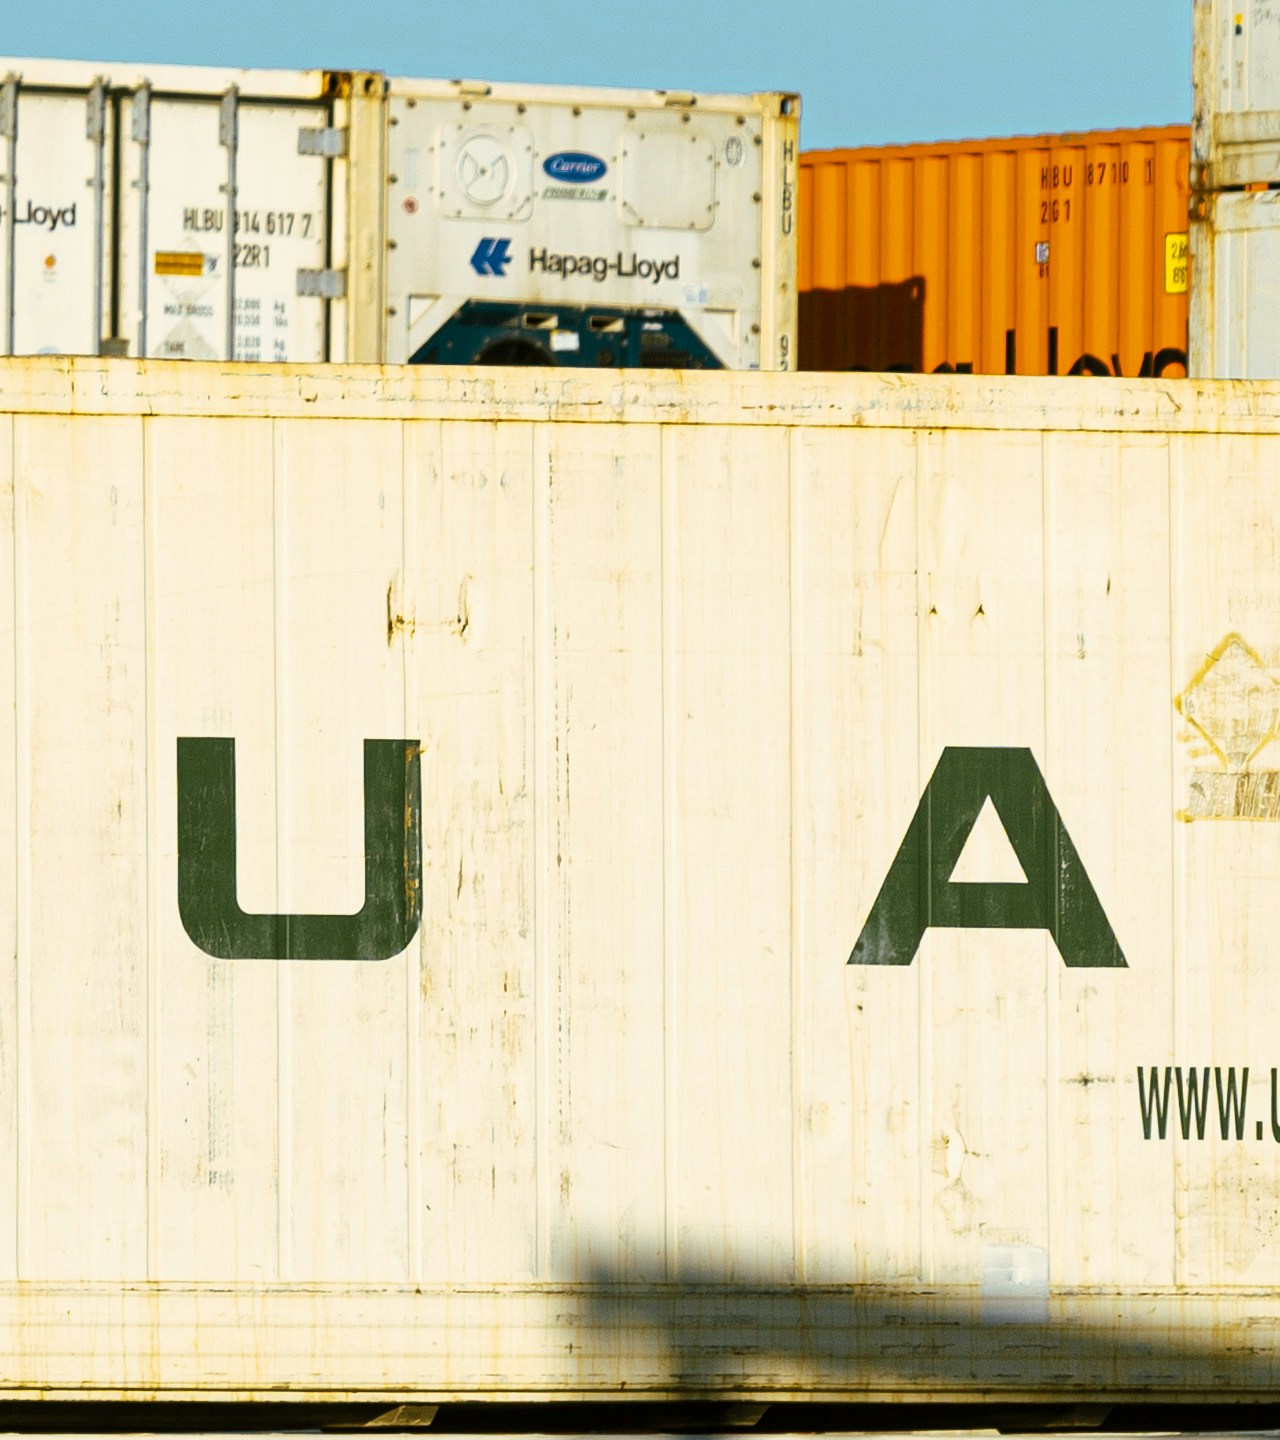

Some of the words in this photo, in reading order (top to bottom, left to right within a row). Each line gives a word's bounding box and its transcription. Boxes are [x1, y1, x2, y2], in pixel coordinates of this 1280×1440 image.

[550, 157, 601, 176] Carrier
[183, 208, 224, 232] HLBU
[528, 247, 680, 284] Hapag-Lloyd
